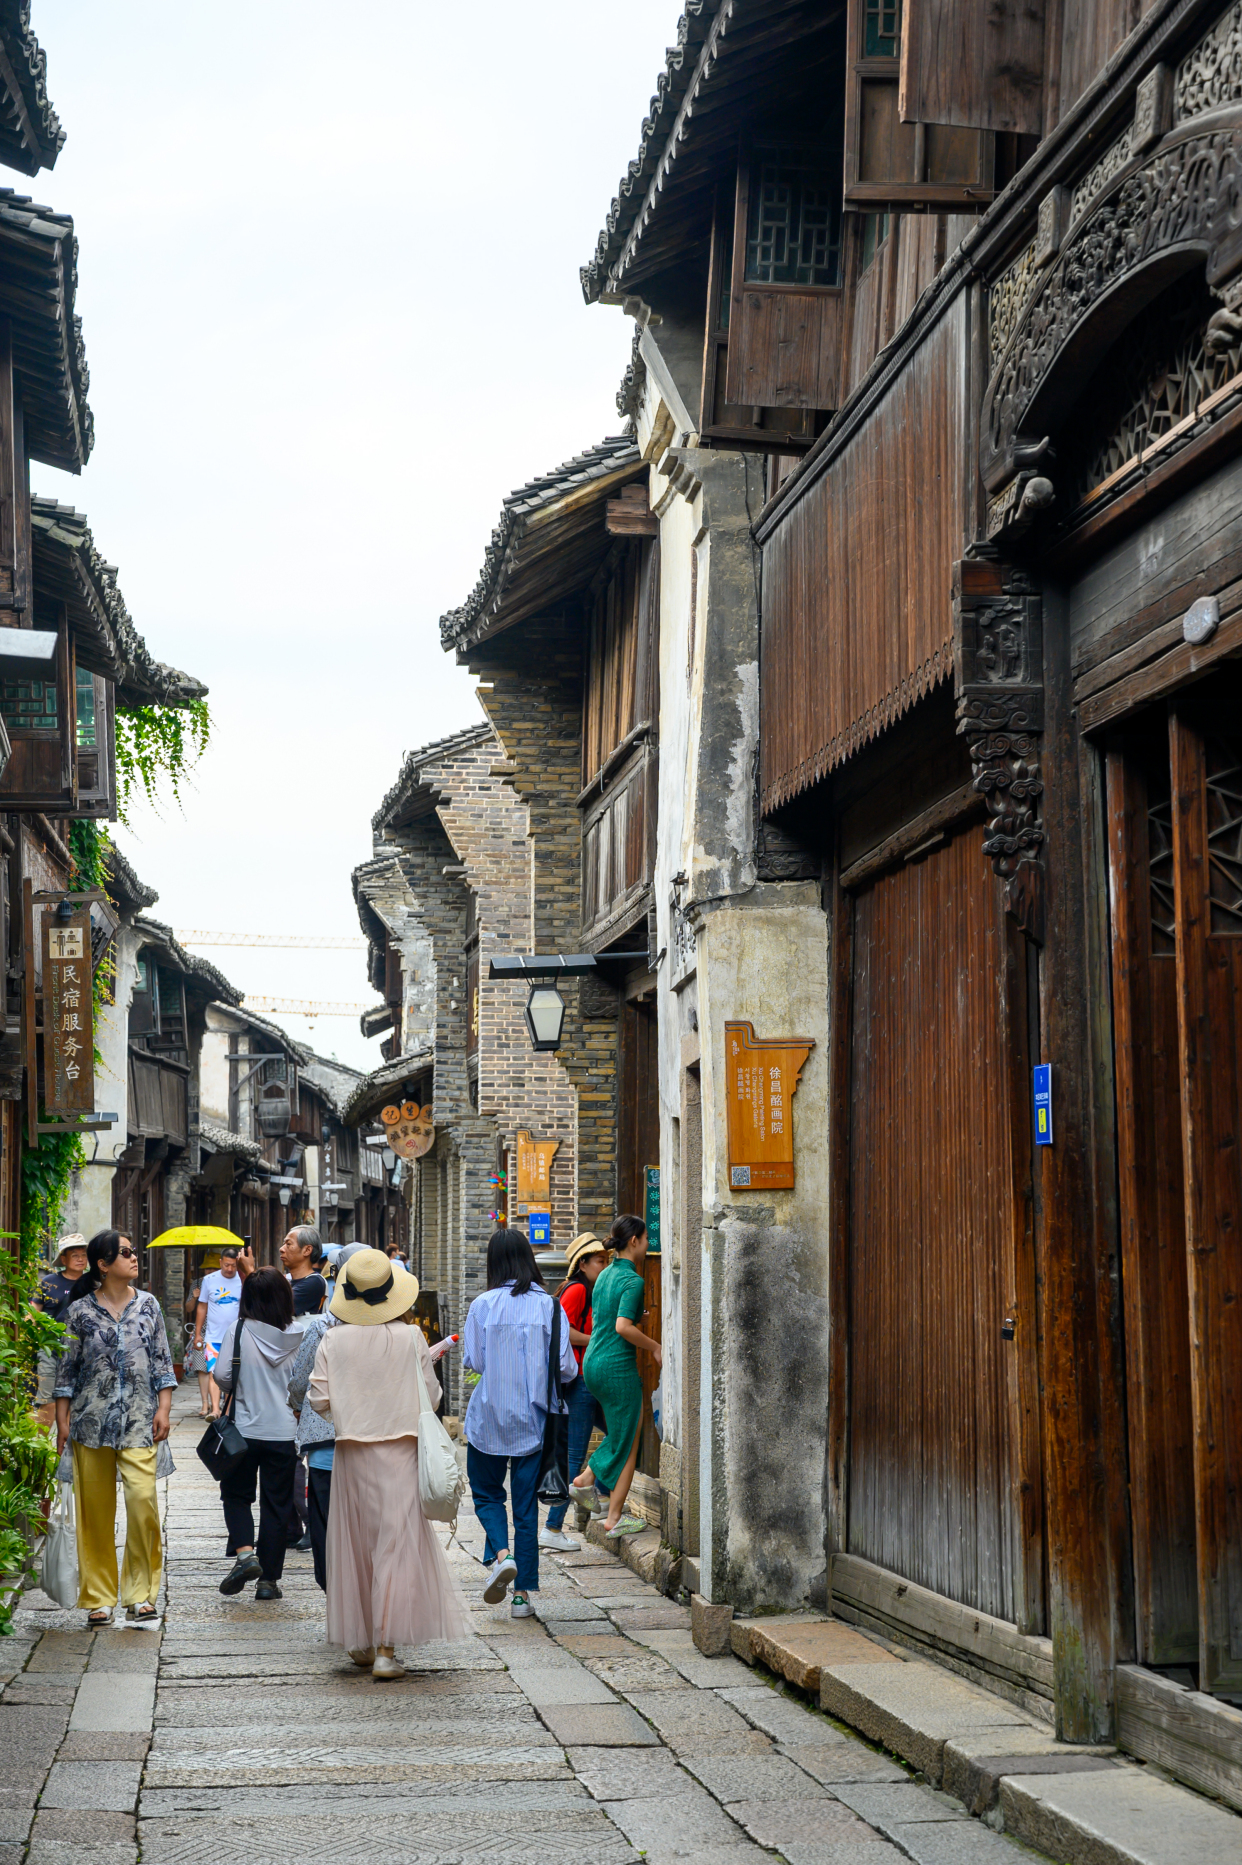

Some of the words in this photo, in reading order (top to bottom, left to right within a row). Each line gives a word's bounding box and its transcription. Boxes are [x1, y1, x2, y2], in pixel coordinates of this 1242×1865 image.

[52, 965, 60, 994] Front
[52, 996, 60, 1021] Desk
[61, 964, 83, 1080] 民宿服务台
[53, 1036, 61, 1067] Guest
[54, 1069, 62, 1101] House
[751, 1067, 757, 1075] Xu
[758, 1067, 764, 1075] Xu
[769, 1066, 783, 1134] 徐昌酩画院
